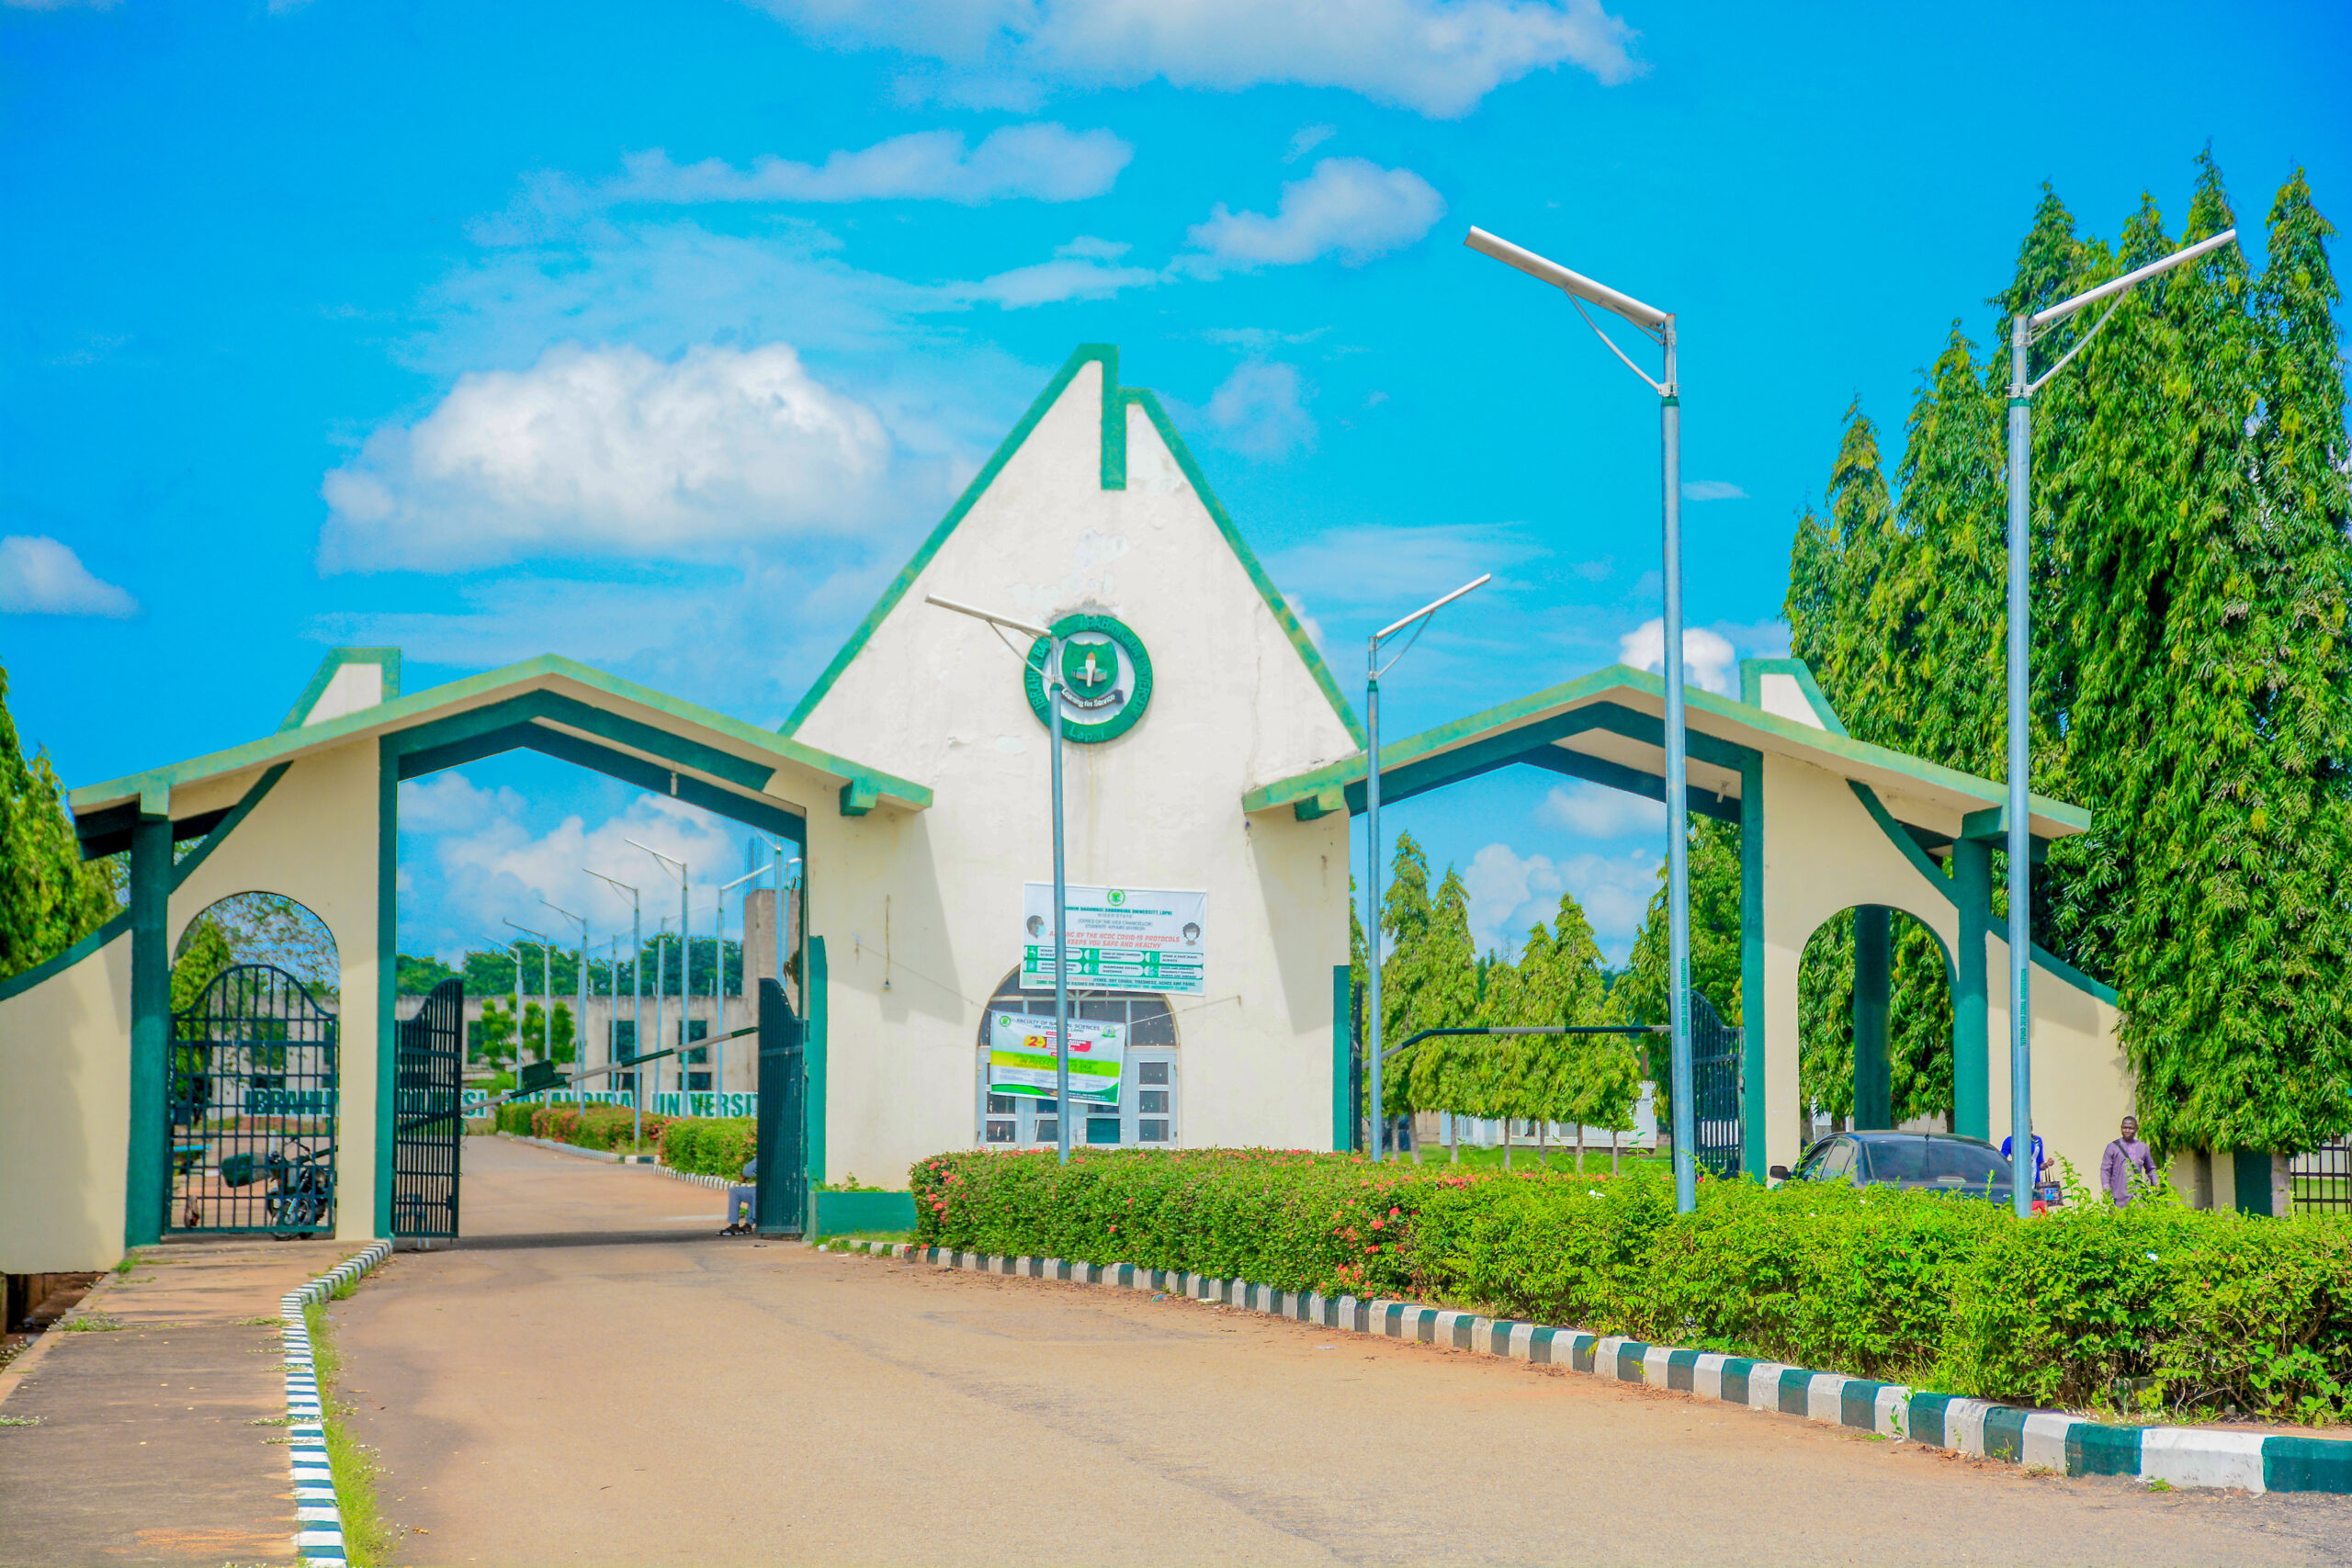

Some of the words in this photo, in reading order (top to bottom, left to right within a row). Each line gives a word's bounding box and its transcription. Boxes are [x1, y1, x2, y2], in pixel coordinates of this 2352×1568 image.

[1084, 699, 1093, 707] for
[1094, 694, 1115, 707] Service
[244, 1089, 340, 1115] IBRAHI
